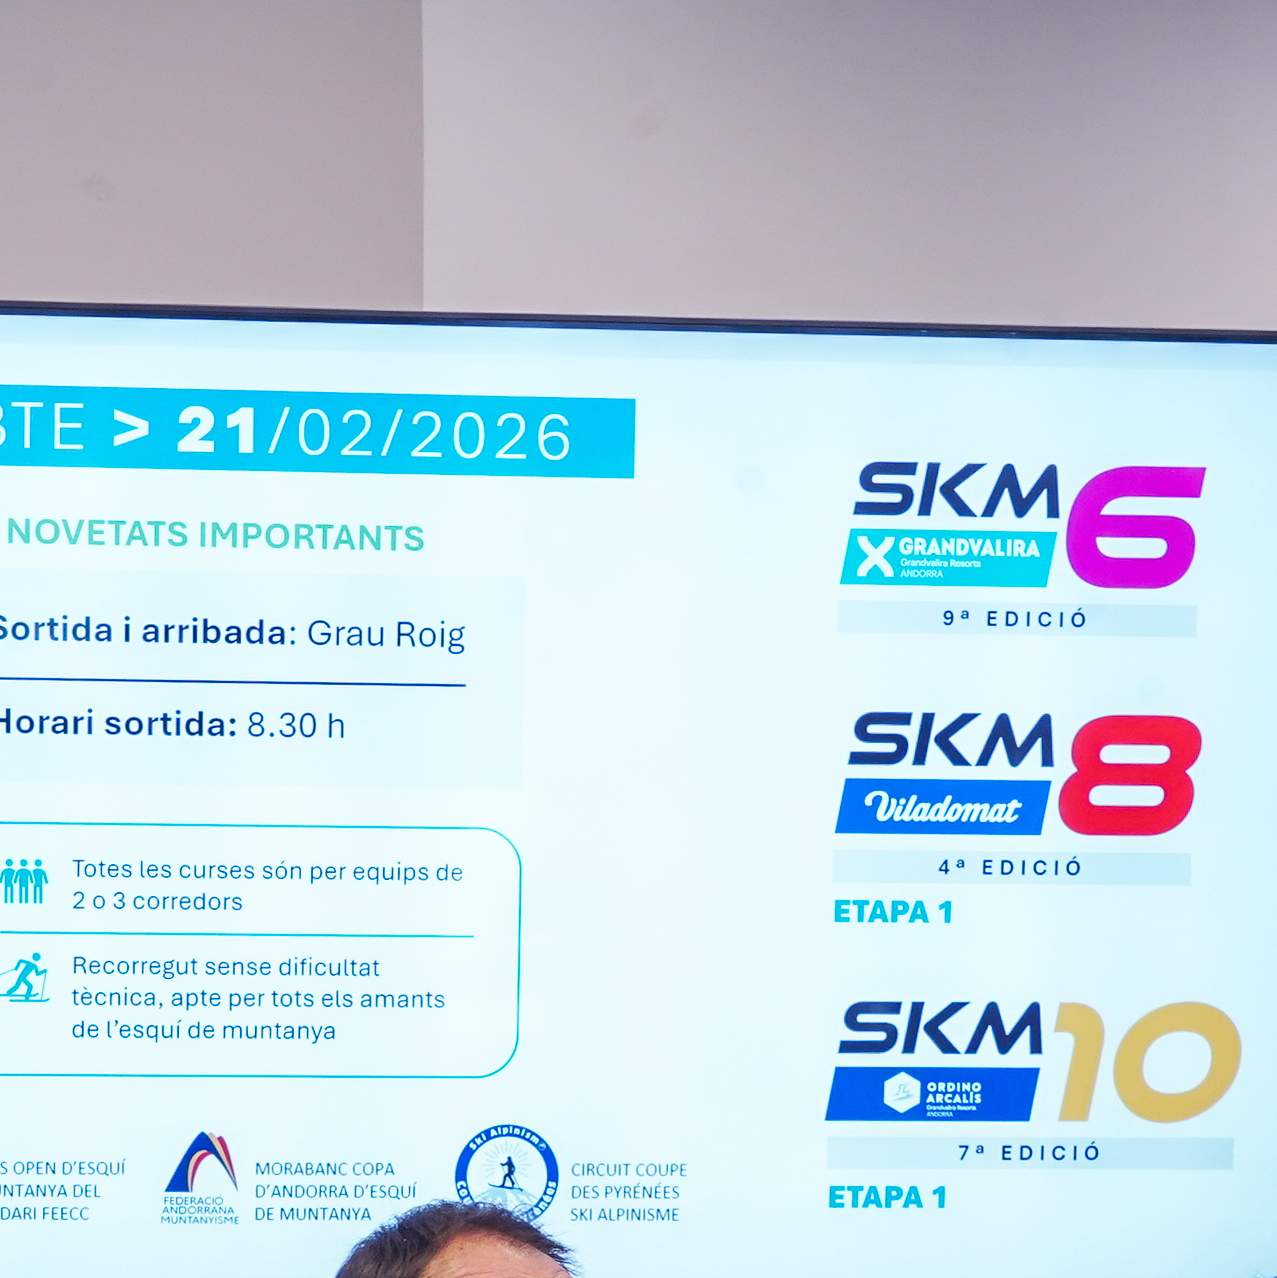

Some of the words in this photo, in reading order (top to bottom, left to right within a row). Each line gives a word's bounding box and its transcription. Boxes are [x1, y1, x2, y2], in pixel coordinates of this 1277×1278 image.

[178, 406, 569, 460] 21/02/2026
[8, 518, 187, 547] NOVETATS
[201, 522, 424, 551] IMPORTANTS
[853, 462, 1059, 518] SKM
[1066, 466, 1206, 589] 6
[899, 537, 1040, 557] GRANDVALIRA
[987, 608, 1085, 627] EDICIÓ
[142, 617, 295, 645] arribada:
[308, 620, 383, 646] Grau
[397, 621, 465, 654] Roig
[105, 710, 236, 736] sortida:
[248, 712, 316, 738] 8.30
[848, 712, 1054, 767] SKM
[1059, 715, 1202, 836] 8
[865, 791, 1022, 823] Viladomat
[72, 860, 132, 878] Totes
[141, 861, 171, 878] les
[180, 865, 254, 879] curses
[263, 861, 301, 879] són
[311, 866, 346, 884] per
[353, 862, 428, 885] equips
[983, 856, 1080, 876] EDICIÓ
[133, 893, 242, 910] corredors
[835, 900, 929, 923] ETAPA
[74, 957, 197, 979] Recorregut
[205, 961, 271, 975] sense
[279, 957, 379, 976] dificultat
[71, 987, 164, 1011] tècnica,
[172, 990, 221, 1011] apte
[229, 993, 265, 1011] per
[271, 991, 314, 1007] tots
[322, 990, 353, 1007] els
[361, 992, 444, 1008] amants
[223, 1023, 335, 1044] muntanya
[838, 1001, 1042, 1055] SKM
[1055, 1002, 1241, 1123] 10
[927, 1082, 981, 1092] ORDINO
[926, 1091, 982, 1104] ARCALÍS
[1002, 1141, 1099, 1160] EDICIÓ
[13, 1162, 55, 1174] OPEN
[256, 1162, 347, 1176] MORABANC
[353, 1163, 395, 1176] COPA
[572, 1163, 631, 1176] CIRCUIT
[636, 1163, 686, 1177] COUPE
[73, 1184, 100, 1197] DEL
[163, 1194, 224, 1206] FEDERACIÓ
[572, 1186, 599, 1199] DES
[605, 1183, 679, 1199] PYRÉNÉES
[829, 1186, 923, 1208] ETAPA
[43, 1207, 88, 1220] FEECC
[163, 1206, 234, 1214] ANDORRANA
[280, 1208, 371, 1220] MUNTANYA
[571, 1208, 592, 1221] SKI
[598, 1208, 678, 1221] ALPINISME
[161, 1216, 239, 1224] MUNTANYISME
